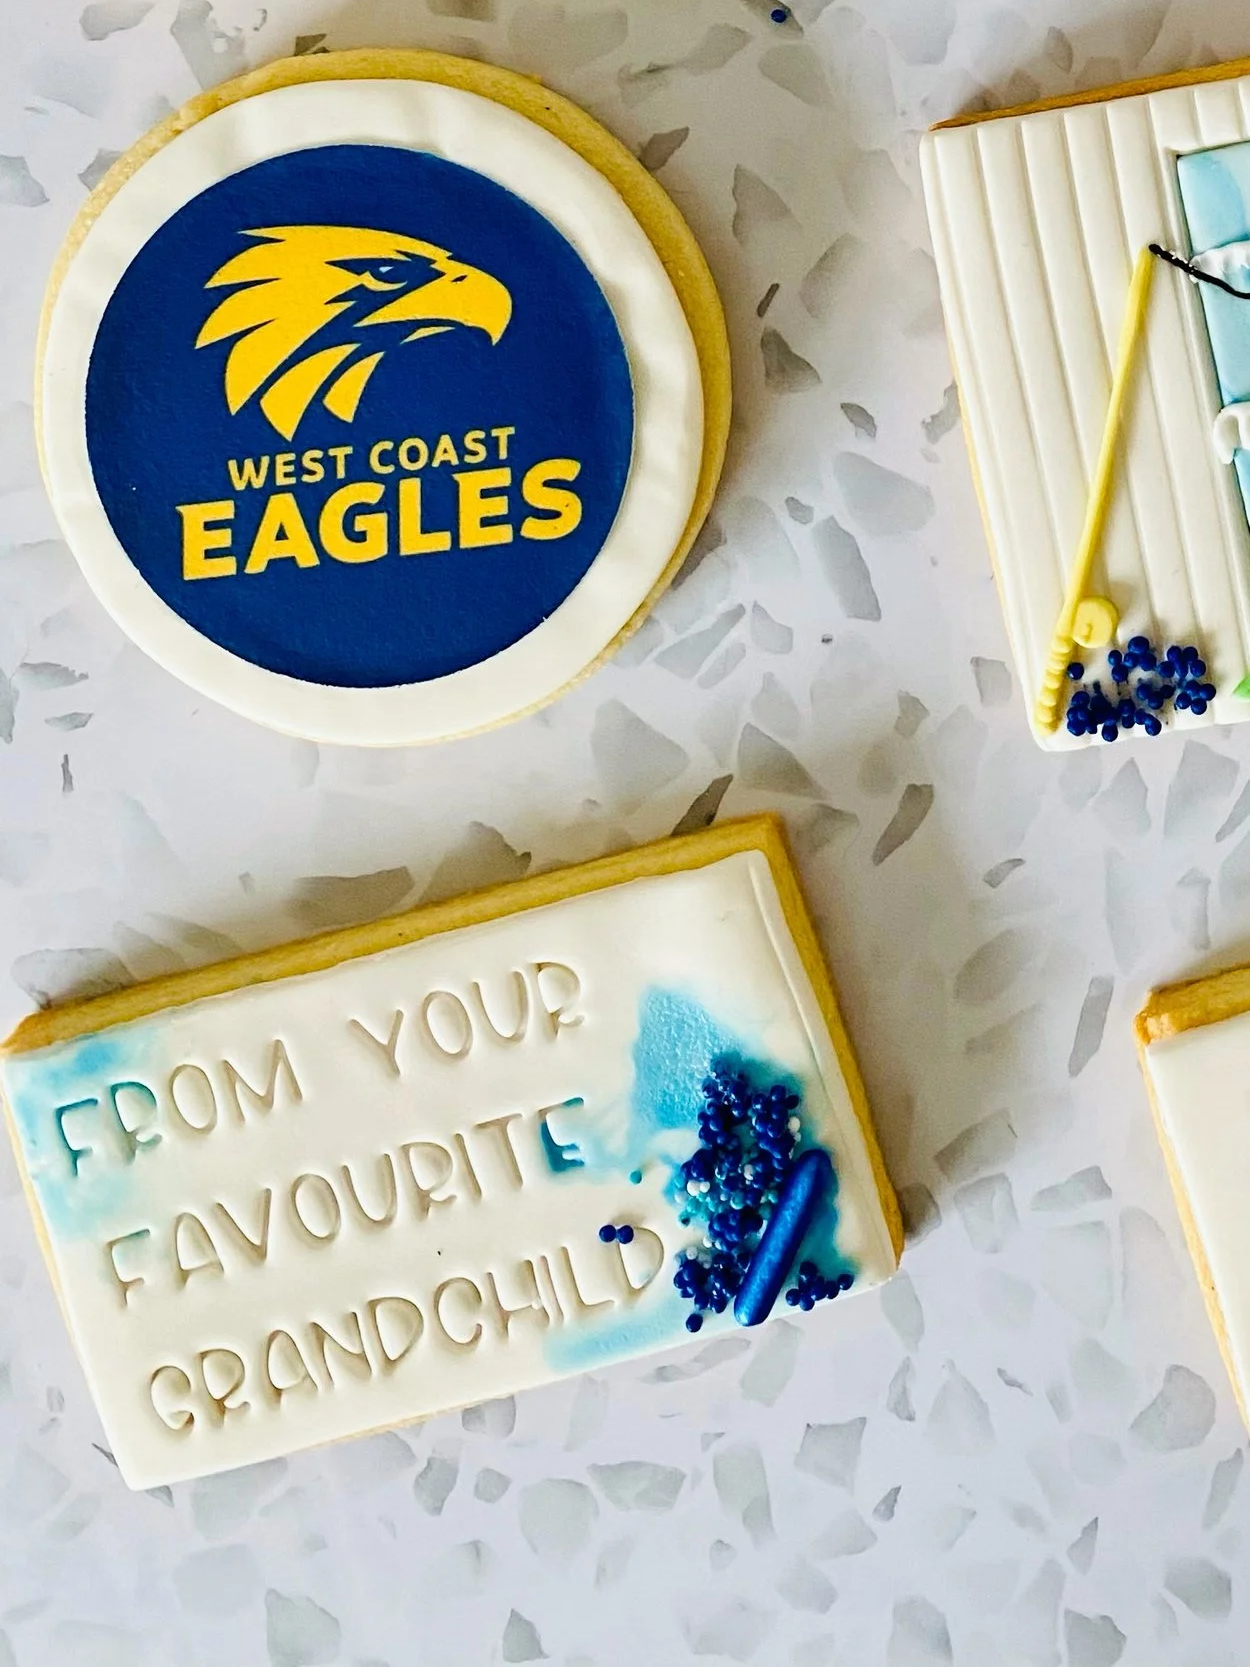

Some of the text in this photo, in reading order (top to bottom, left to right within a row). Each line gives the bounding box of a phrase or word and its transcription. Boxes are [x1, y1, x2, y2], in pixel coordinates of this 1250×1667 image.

[175, 458, 583, 581] EAGLES
[227, 426, 516, 491] WEST COAST
[54, 961, 587, 1177] FROM YOUR
[105, 1097, 587, 1309] FAVOURITE
[149, 1225, 665, 1433] GRANDCHILD
